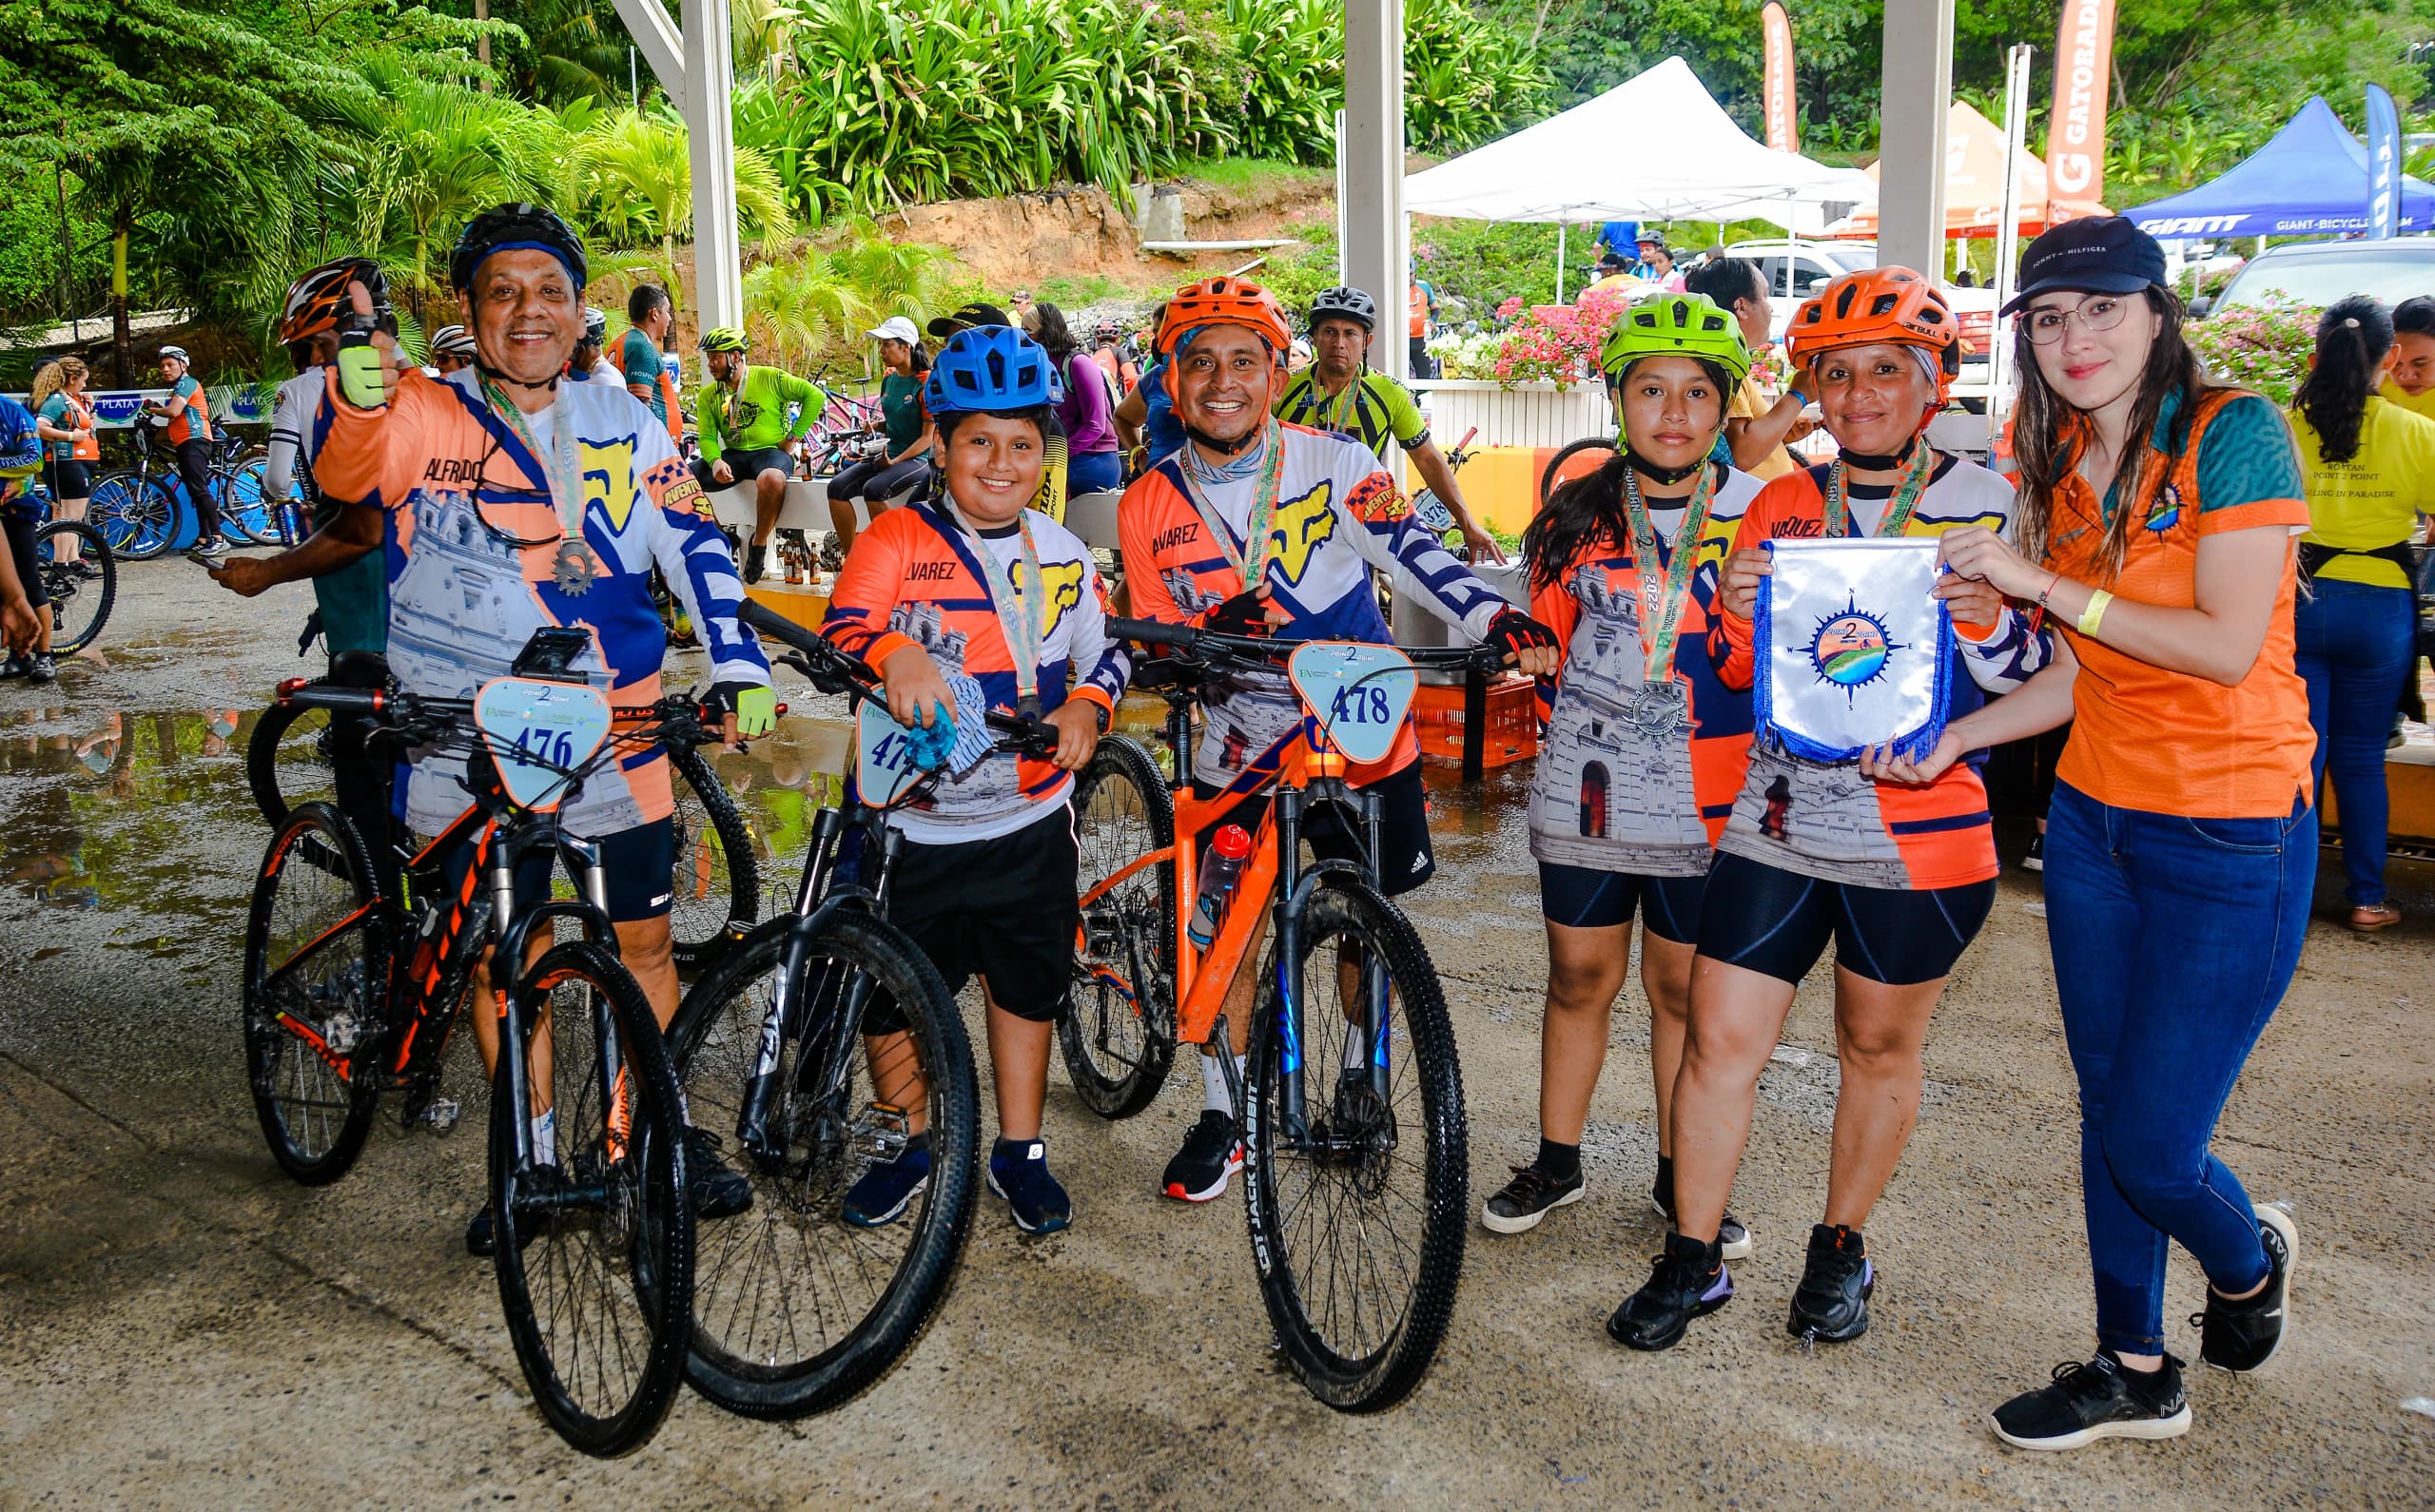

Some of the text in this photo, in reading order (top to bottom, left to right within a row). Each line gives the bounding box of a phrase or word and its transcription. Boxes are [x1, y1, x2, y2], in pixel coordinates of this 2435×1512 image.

[2066, 0, 2098, 145] GATORAD
[2138, 214, 2251, 236] GIANT
[102, 399, 135, 410] PLATA
[2348, 490, 2396, 498] PARADISE
[1423, 501, 1447, 524] 378
[1645, 573, 1660, 612] 2022
[1842, 622, 1857, 639] 2
[1345, 647, 1358, 661] 2
[537, 686, 552, 701] 2
[1332, 685, 1391, 724] 478
[510, 727, 573, 769] 476
[1246, 1080, 1270, 1271] CST JACK RABBIT
